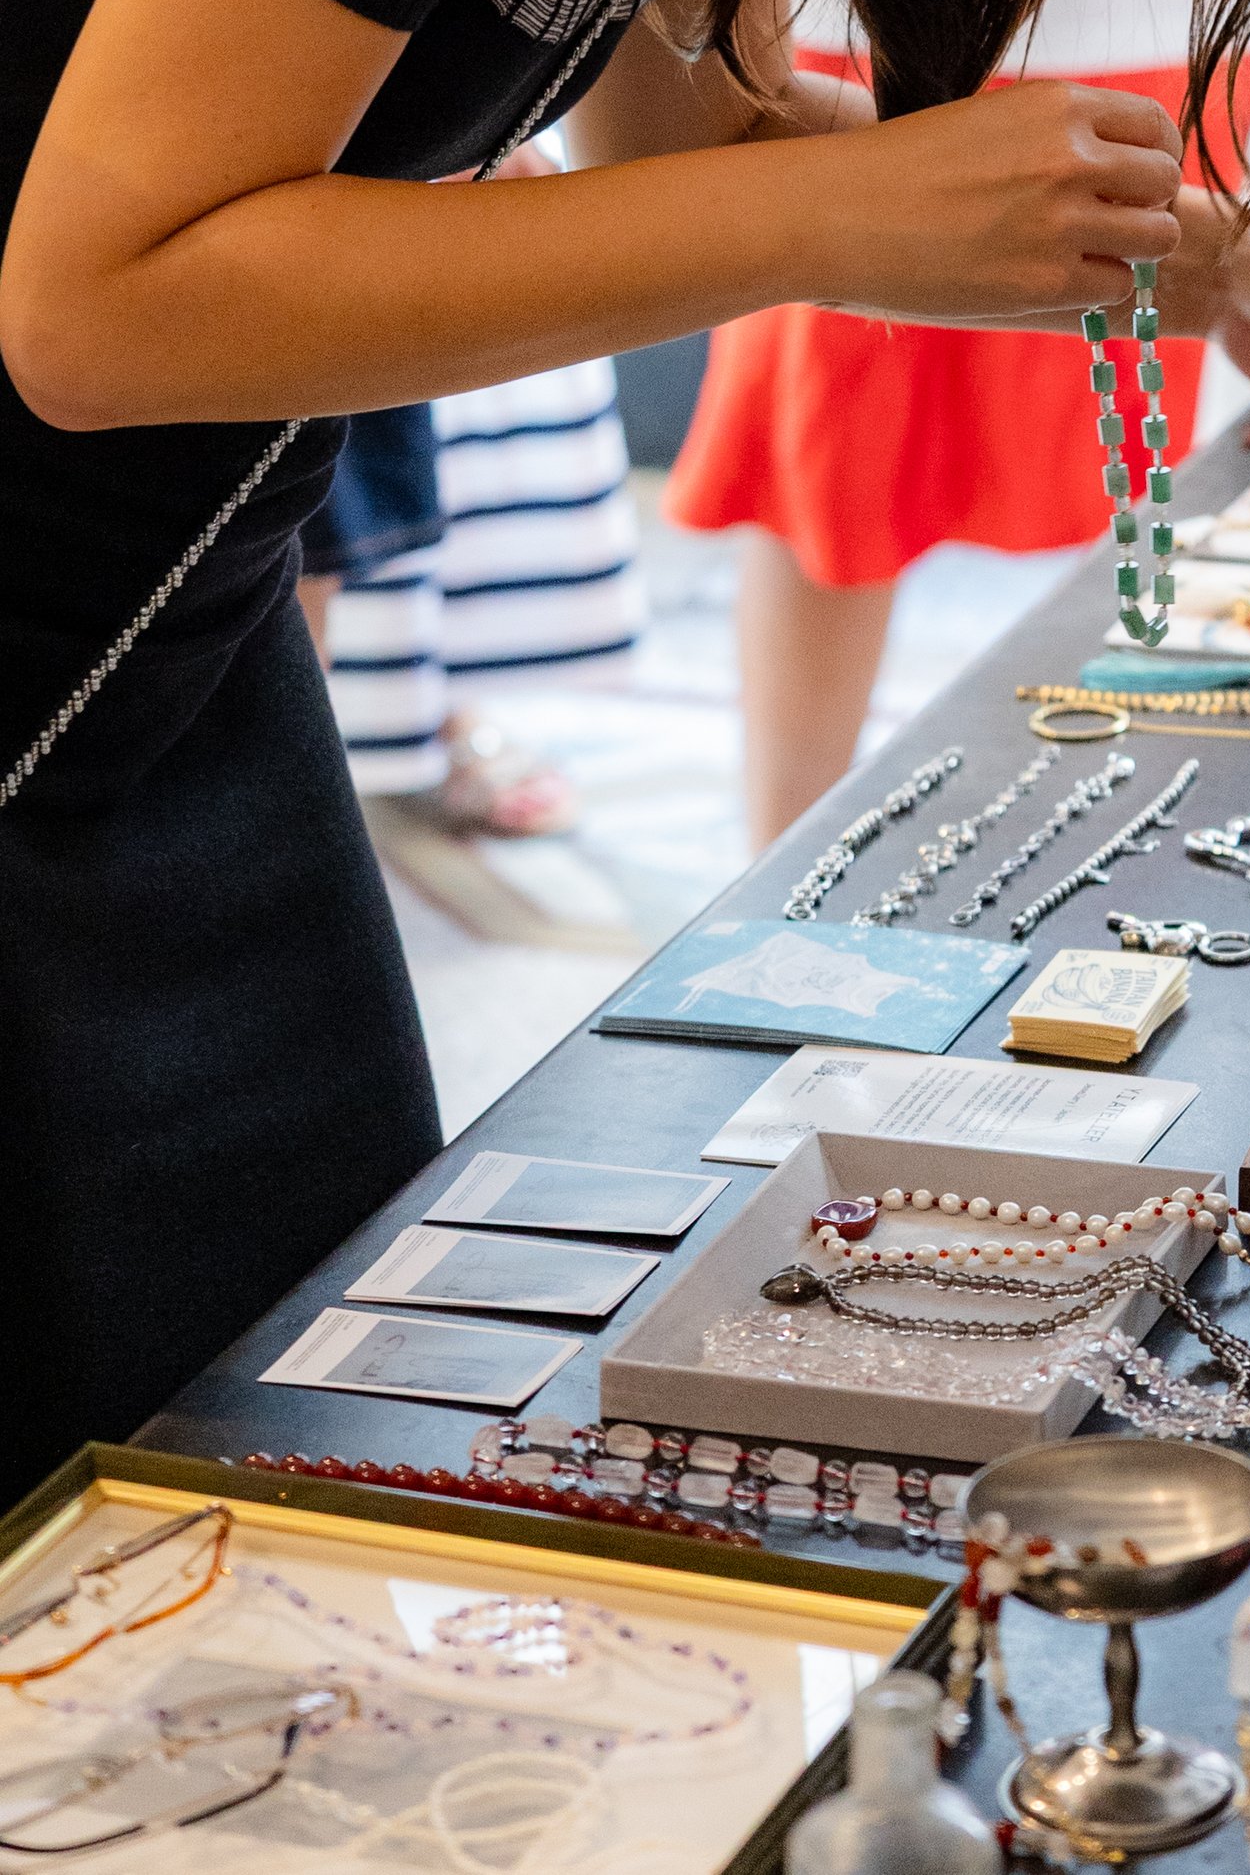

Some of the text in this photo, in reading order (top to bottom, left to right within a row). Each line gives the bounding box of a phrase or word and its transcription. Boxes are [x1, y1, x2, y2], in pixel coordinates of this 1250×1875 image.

[1101, 967, 1133, 1004] BANANA
[1122, 968, 1157, 1007] TAIWAN
[1081, 1100, 1127, 1142] ATELIER
